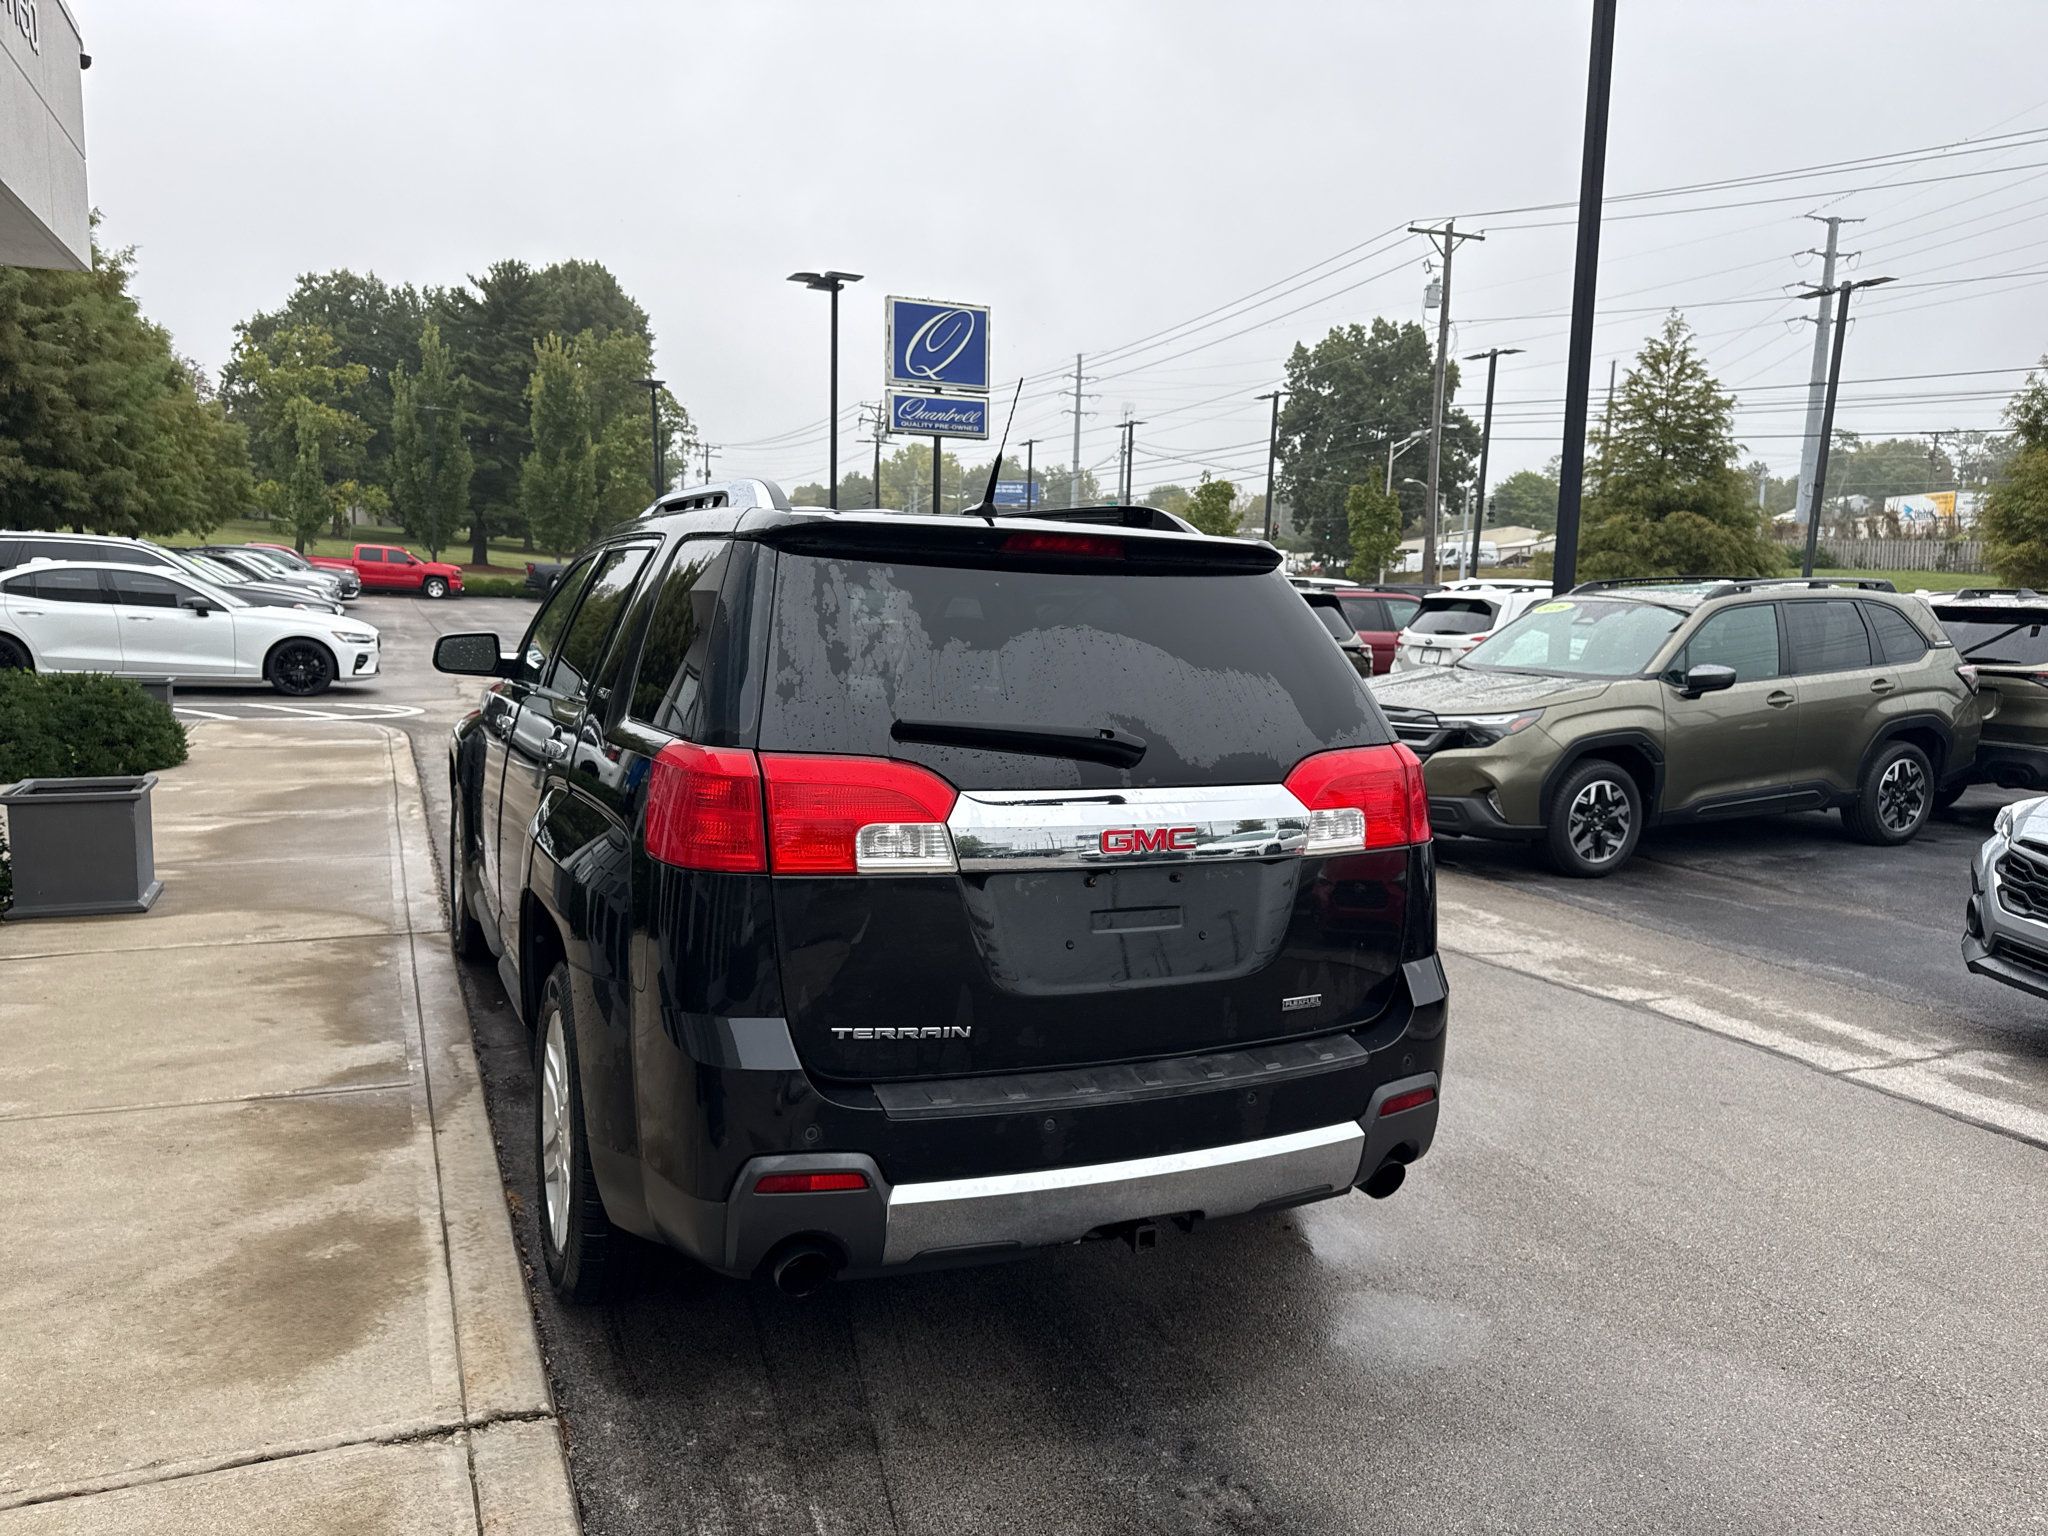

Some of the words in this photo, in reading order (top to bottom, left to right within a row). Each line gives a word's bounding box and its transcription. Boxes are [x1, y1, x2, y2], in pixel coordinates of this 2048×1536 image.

[905, 309, 975, 381] Q
[897, 397, 982, 424] Quantrell
[900, 420, 933, 429] QUALITY
[934, 422, 979, 432] PRE-OWNED
[1100, 825, 1197, 855] GMC
[831, 1026, 972, 1040] TERRAIN
